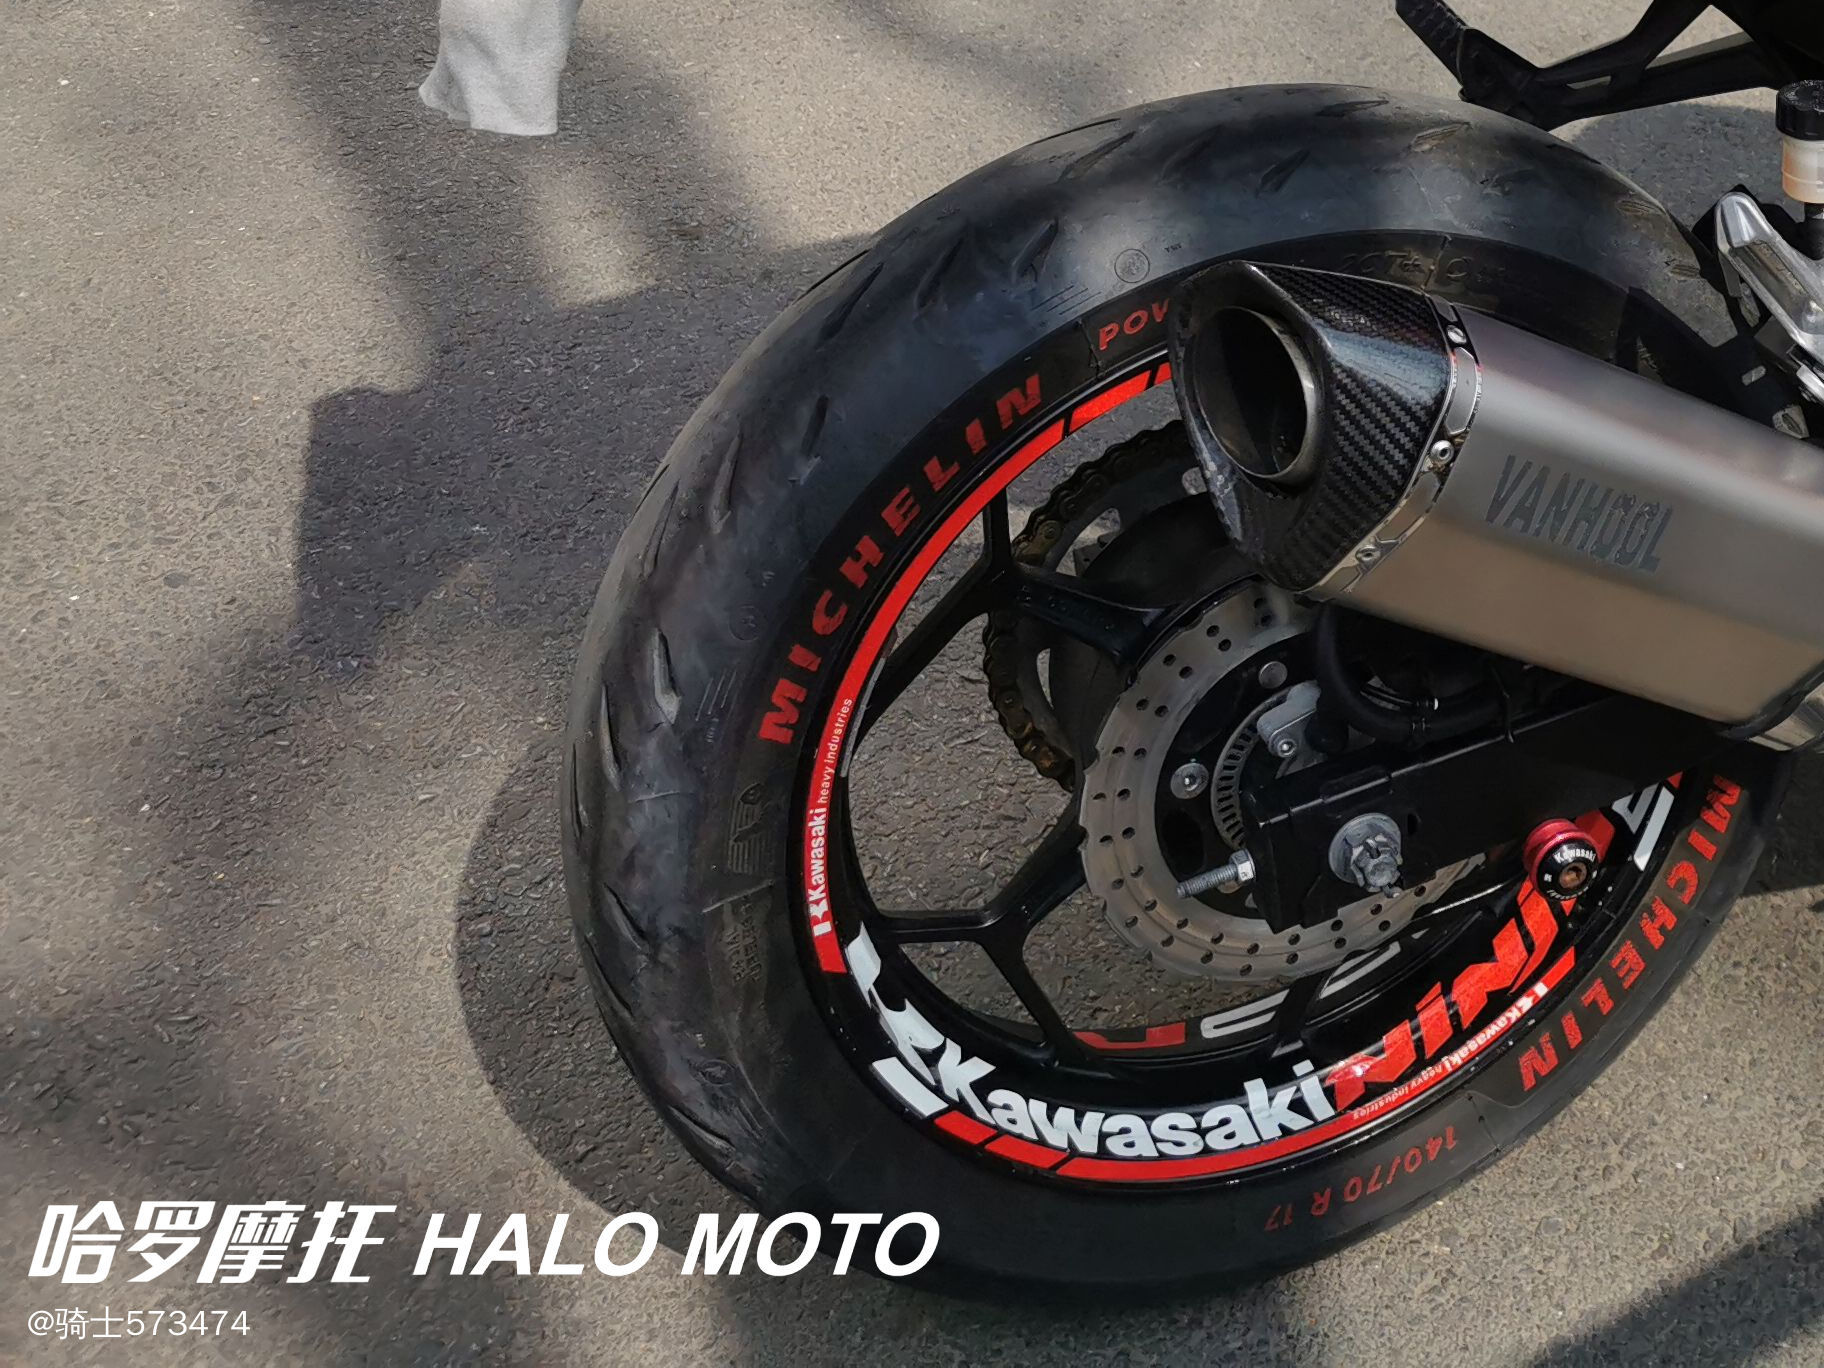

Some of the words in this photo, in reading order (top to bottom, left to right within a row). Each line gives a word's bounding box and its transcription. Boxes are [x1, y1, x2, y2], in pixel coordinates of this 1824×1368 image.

[1484, 454, 1673, 573] VANHOOL
[759, 374, 1041, 745] MICHELIN
[823, 698, 852, 764] industries
[817, 766, 836, 804] heavy
[808, 807, 828, 902] Kawasaki
[1553, 844, 1597, 863] Kawasaki
[1521, 775, 1742, 1092] MICHELIN
[1441, 1006, 1523, 1072] Kawasaki
[936, 1038, 1336, 1157] Kawasaki
[1353, 1086, 1410, 1120] industries
[1344, 1125, 1458, 1203] 140/70
[1264, 1203, 1293, 1232] 17
[1310, 1187, 1331, 1216] R
